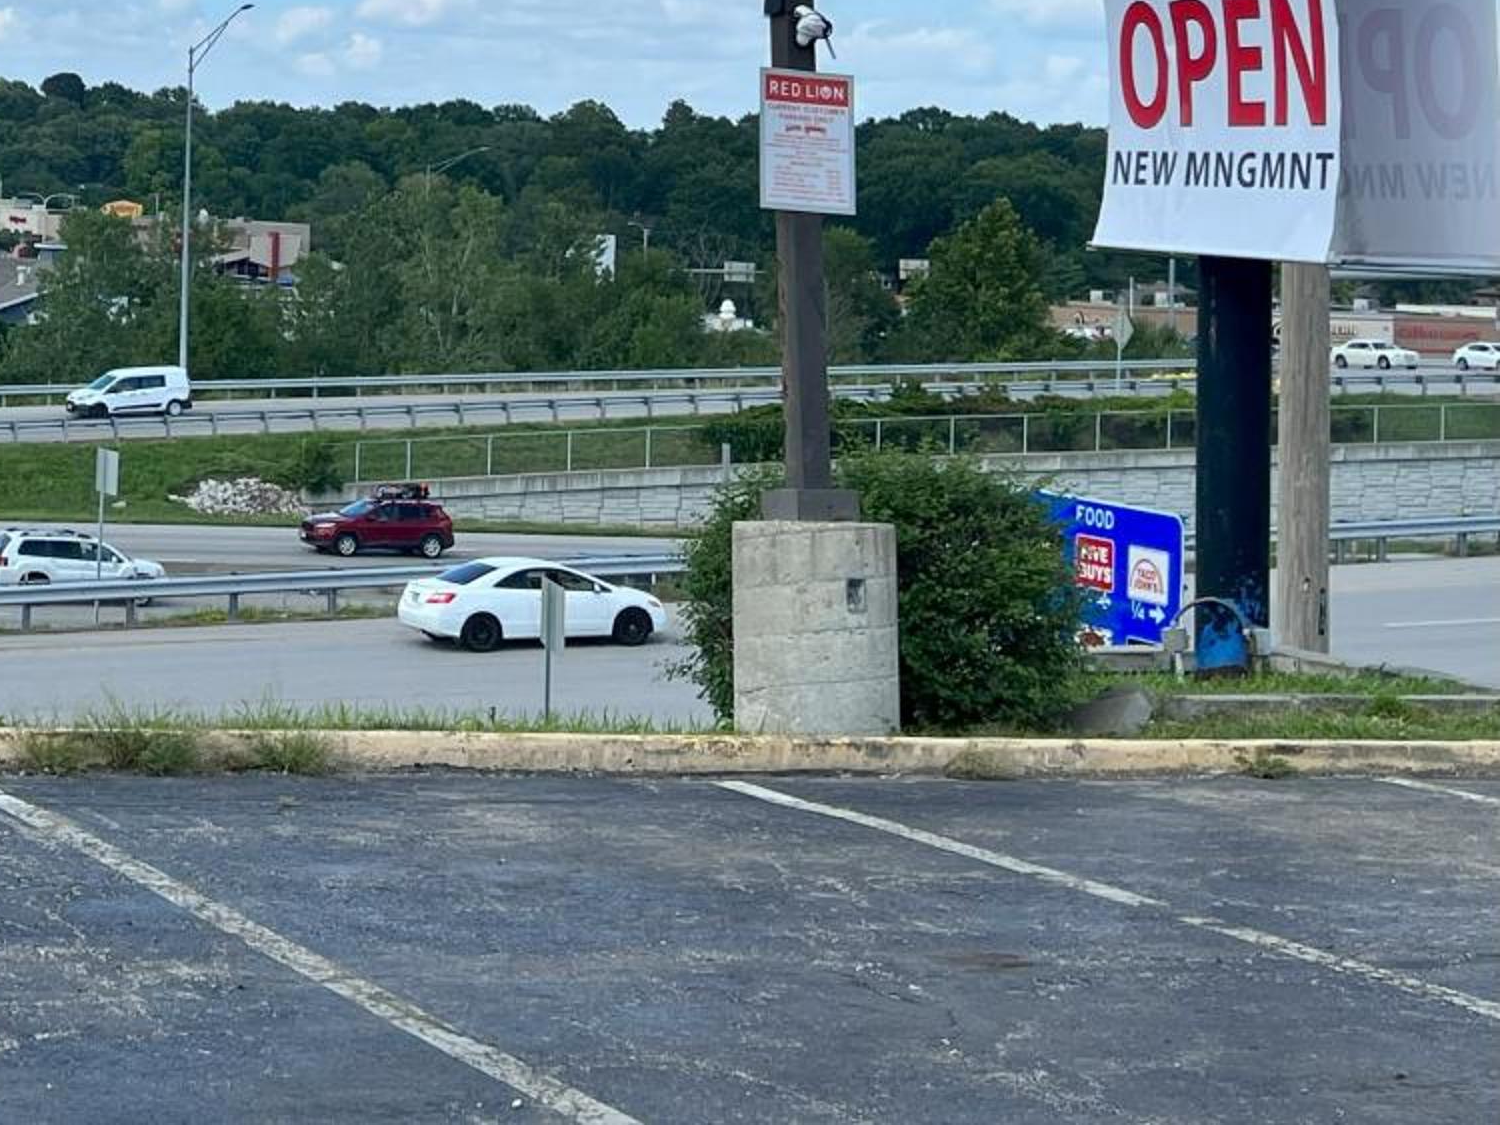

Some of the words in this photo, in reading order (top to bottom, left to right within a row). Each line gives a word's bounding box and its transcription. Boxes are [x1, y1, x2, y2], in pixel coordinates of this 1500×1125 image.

[769, 79, 801, 98] RED
[805, 84, 845, 101] LION
[1112, 150, 1179, 186] NEW
[1185, 151, 1335, 191] MNGMNT
[1075, 505, 1115, 529] FOOD
